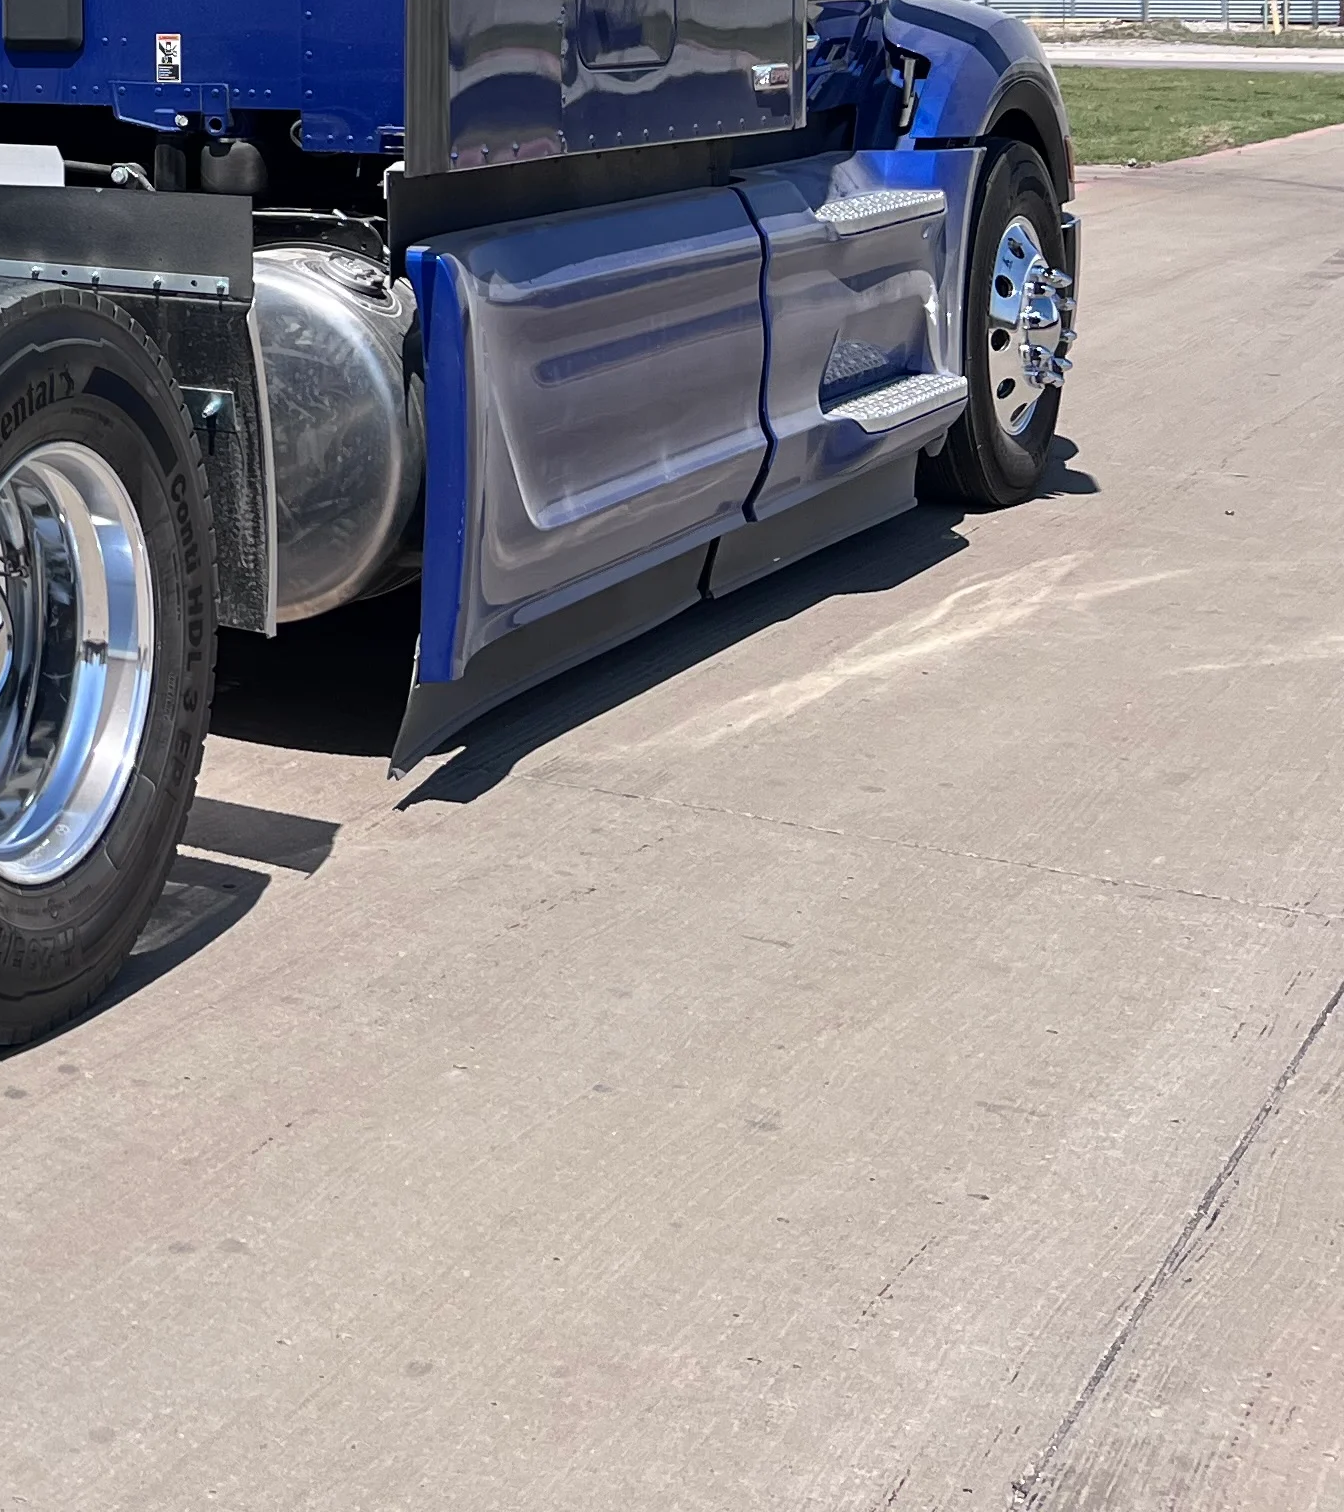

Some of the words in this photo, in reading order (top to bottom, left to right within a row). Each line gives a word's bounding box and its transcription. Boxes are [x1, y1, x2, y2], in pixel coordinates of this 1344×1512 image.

[170, 473, 202, 576] Conti
[185, 586, 205, 672] HDL
[182, 689, 198, 714] 3
[171, 728, 192, 783] EP
